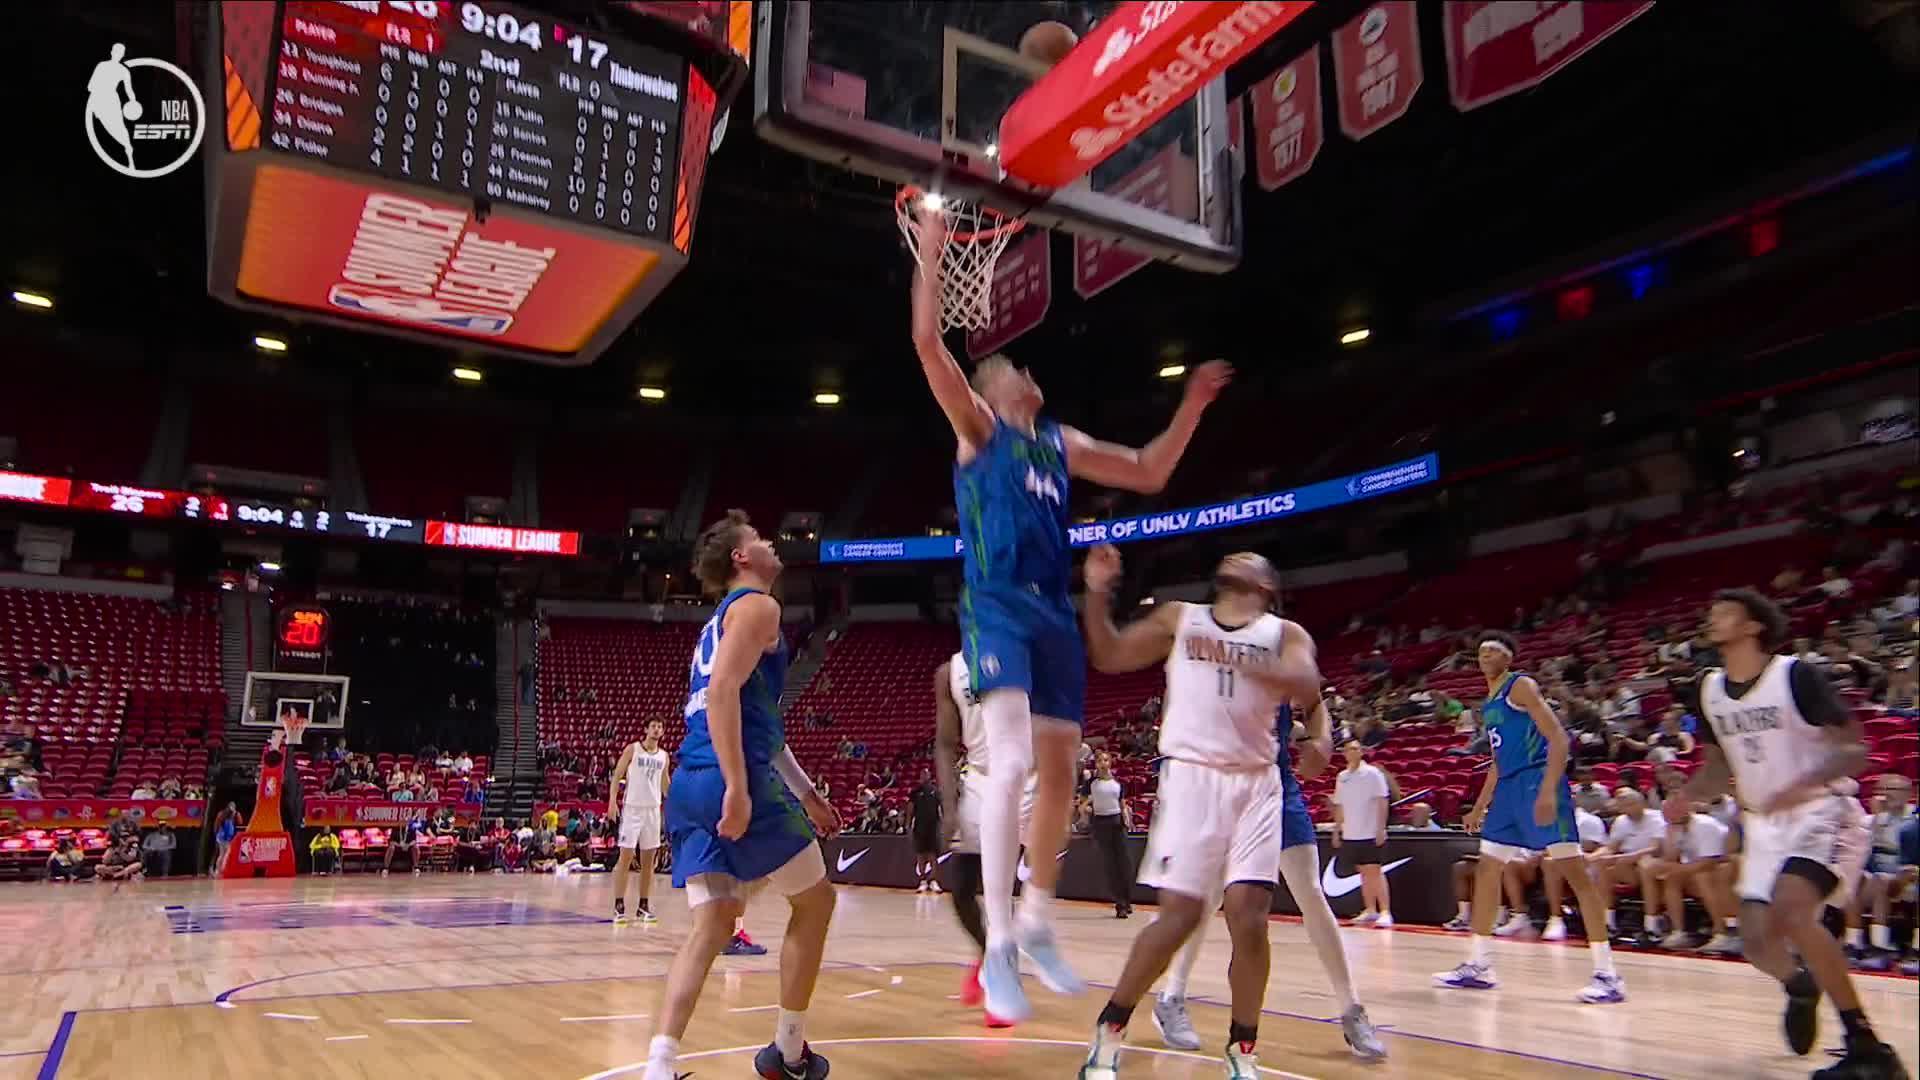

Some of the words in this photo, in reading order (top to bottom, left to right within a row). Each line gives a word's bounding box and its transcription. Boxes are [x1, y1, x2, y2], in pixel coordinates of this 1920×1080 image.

[425, 33, 433, 53] 1
[461, 2, 543, 51] 9:04
[480, 49, 520, 78] 2nd
[567, 34, 608, 69] 17
[380, 62, 393, 83] 6
[411, 70, 420, 90] 1
[439, 78, 450, 99] 0
[469, 86, 480, 107] 0
[589, 80, 600, 101] 0
[378, 83, 390, 103] 0
[407, 91, 419, 111] 0
[436, 98, 448, 118] 0
[466, 105, 478, 127] 0
[376, 105, 387, 125] 0
[405, 112, 416, 132] 0
[435, 120, 444, 140] 1
[465, 127, 474, 148] 1
[577, 116, 587, 135] 0
[603, 122, 612, 141] 0
[655, 136, 662, 155] 1
[373, 126, 385, 146] 2
[402, 133, 414, 153] 2
[431, 141, 443, 161] 0
[462, 148, 473, 168] 0
[575, 135, 585, 155] 0
[602, 142, 609, 160] 1
[626, 148, 636, 167] 0
[369, 148, 381, 167] 4
[401, 154, 410, 175] 1
[431, 161, 440, 182] 1
[461, 168, 470, 188] 1
[600, 162, 607, 181] 1
[624, 168, 634, 187] 0
[650, 175, 660, 193] 0
[567, 174, 585, 195] 10
[622, 187, 632, 207] 0
[648, 194, 658, 213] 0
[569, 195, 579, 214] 0
[595, 200, 604, 220] 0
[620, 207, 630, 226] 0
[647, 212, 656, 232] 0
[341, 192, 469, 296] SUMMER
[435, 231, 557, 313] LEAGUE
[237, 505, 283, 525] 9:04
[365, 522, 391, 539] 17
[1111, 520, 1138, 538] OF
[1141, 512, 1192, 533] UNLV
[1195, 493, 1296, 527] ATHLETICS
[458, 524, 513, 548] SUMMER
[514, 529, 561, 553] LEAGUE
[286, 622, 319, 644] 20
[1216, 667, 1234, 698] 11
